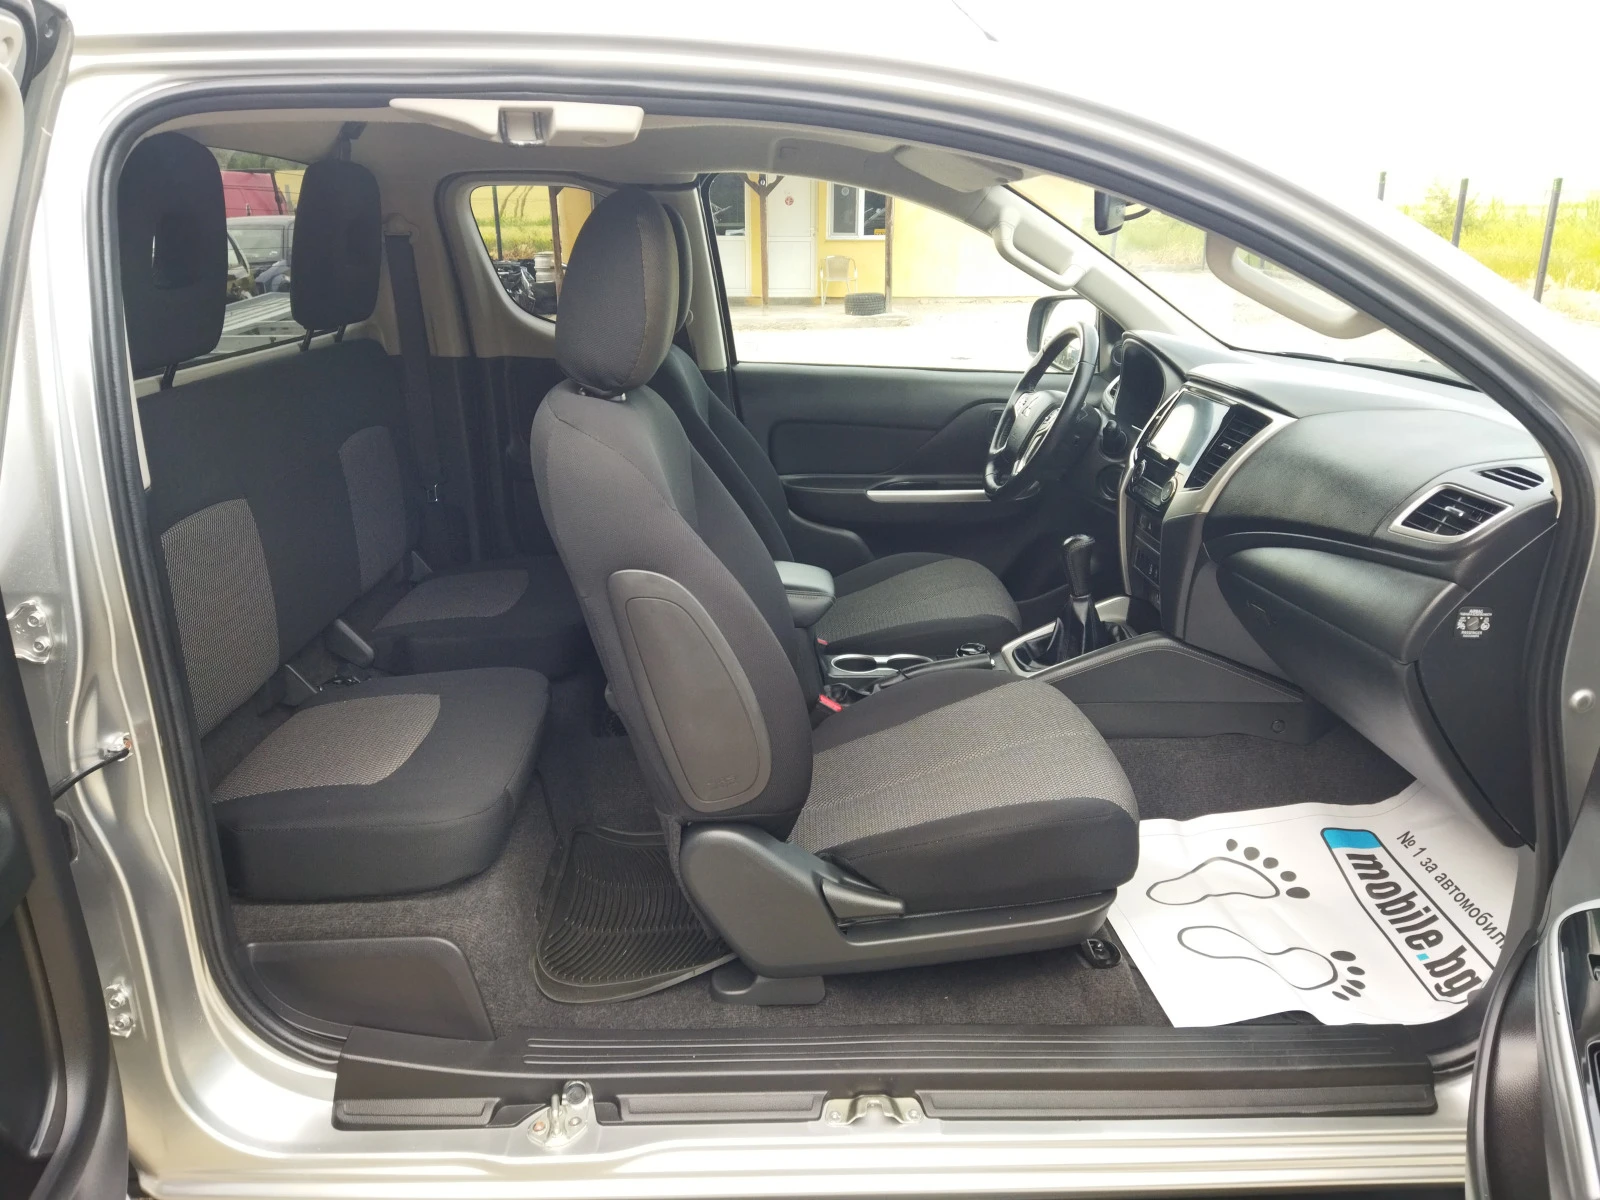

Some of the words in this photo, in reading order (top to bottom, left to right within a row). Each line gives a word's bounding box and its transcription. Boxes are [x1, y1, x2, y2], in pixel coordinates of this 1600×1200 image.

[1412, 847, 1427, 857] 1
[1419, 857, 1438, 873] за
[1345, 854, 1483, 998] mobile.bg
[1434, 872, 1506, 949] автомобил
